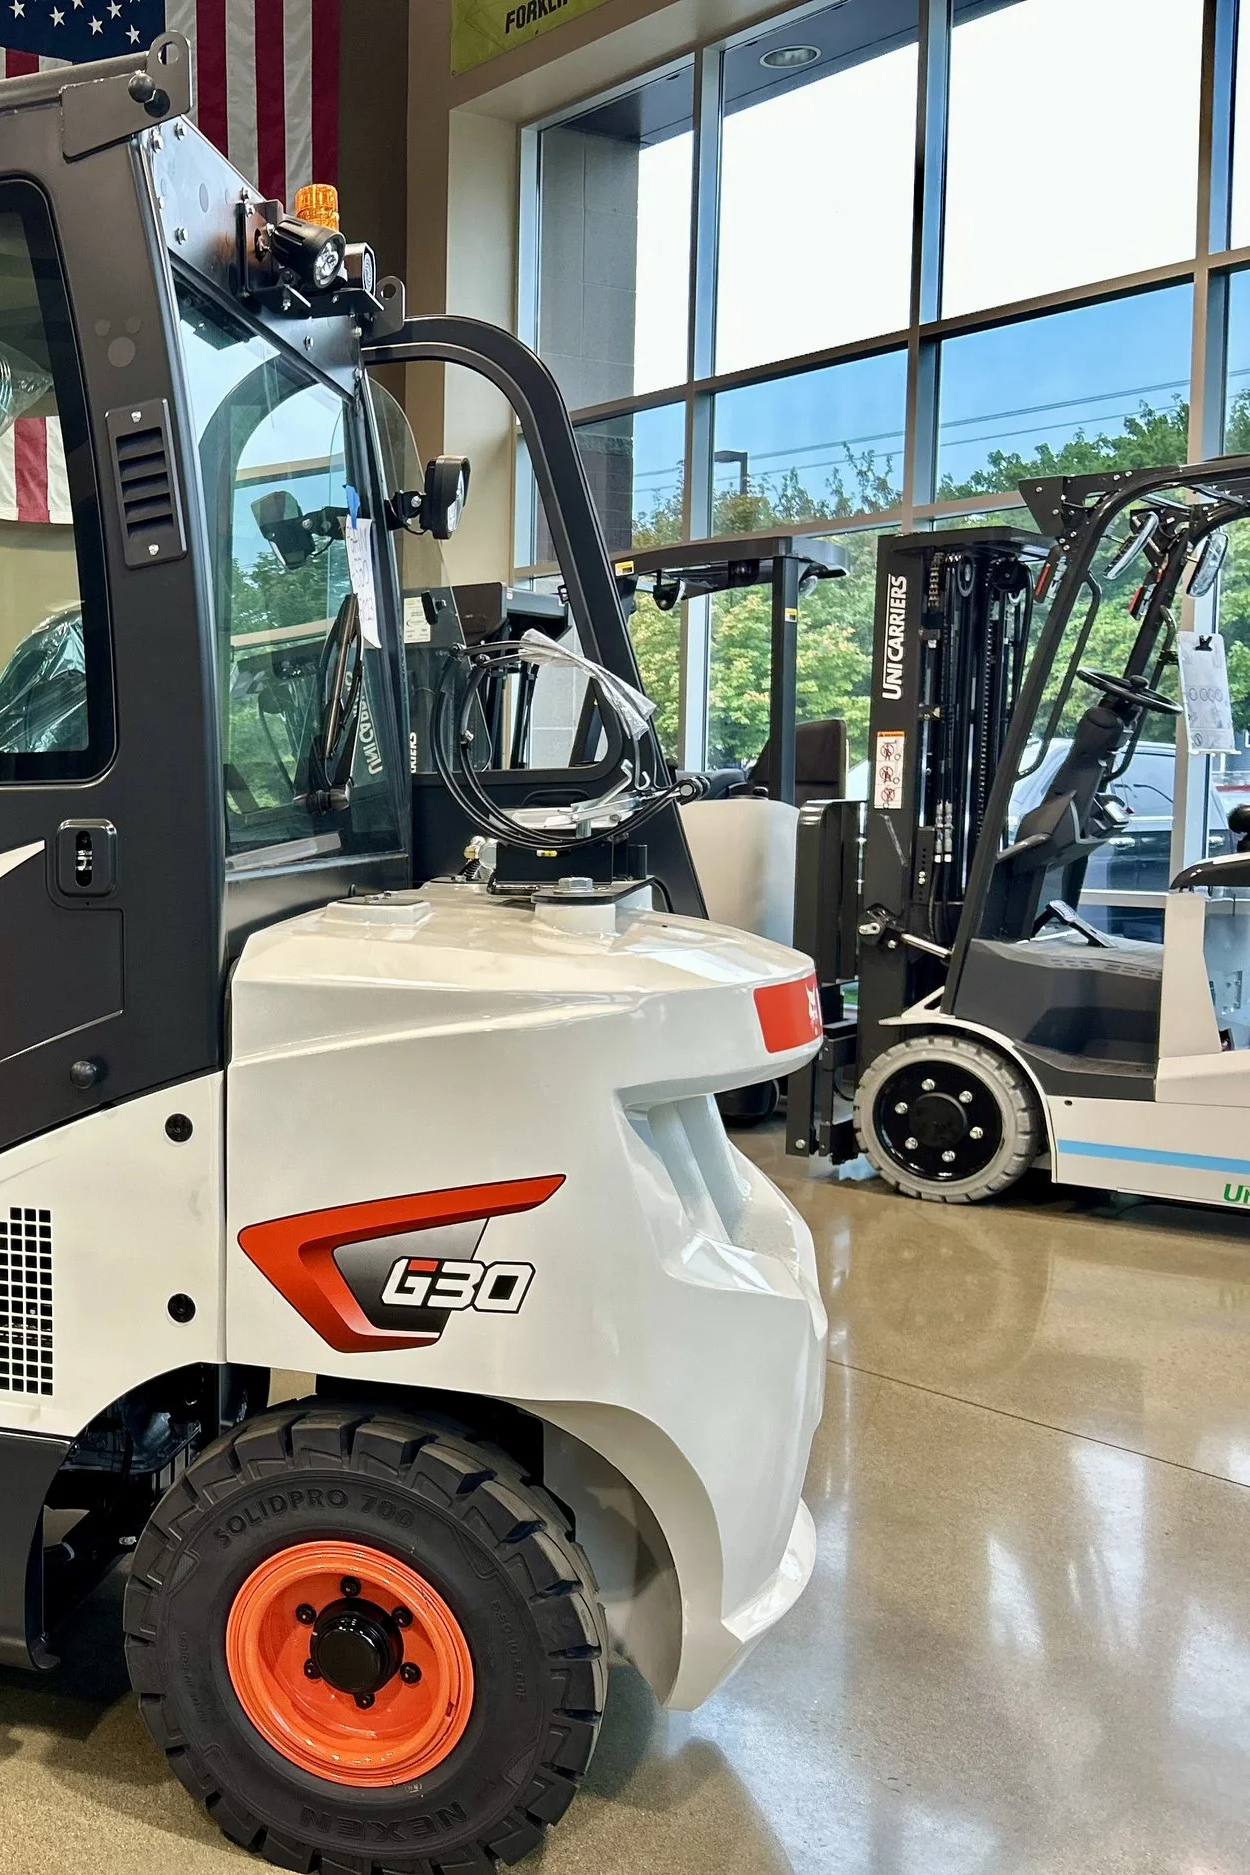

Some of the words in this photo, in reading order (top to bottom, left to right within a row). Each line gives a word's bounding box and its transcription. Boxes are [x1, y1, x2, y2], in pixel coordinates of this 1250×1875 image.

[505, 0, 569, 34] FORKL
[882, 573, 907, 700] UNICARRIERS
[381, 1256, 536, 1314] G30
[213, 1487, 350, 1549] SOLIDPRO
[299, 1799, 470, 1843] NEXEN
